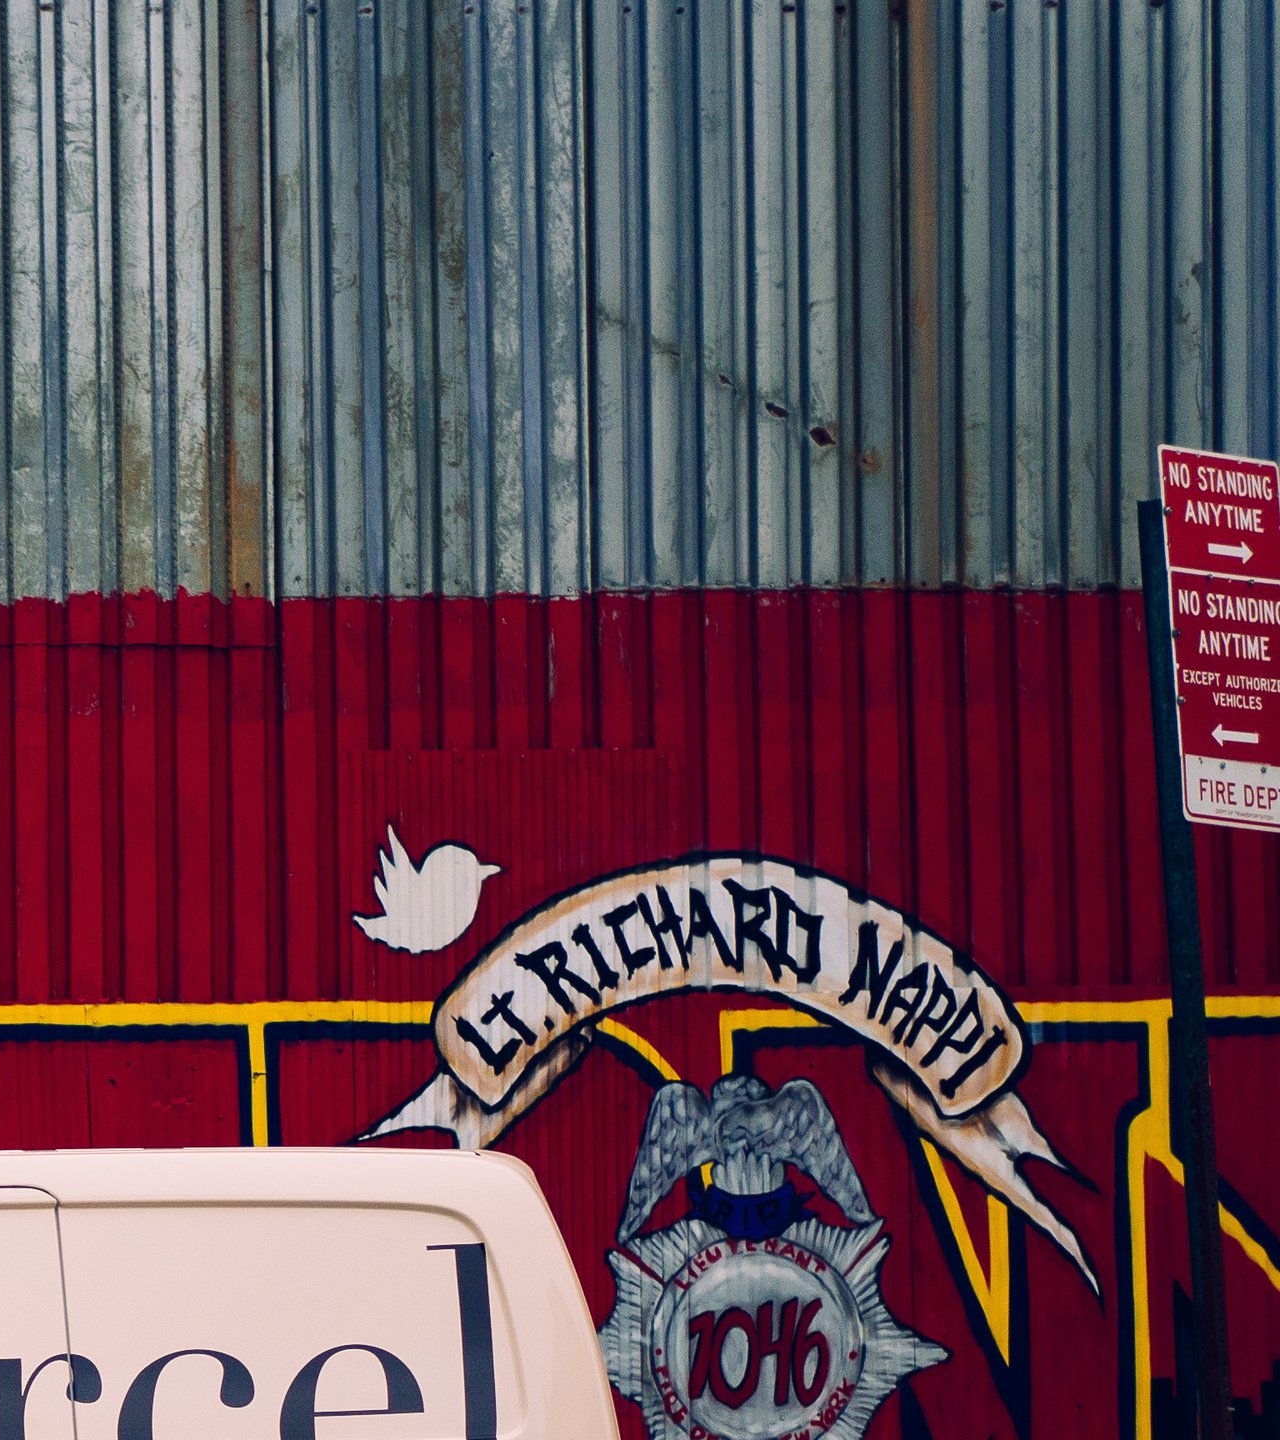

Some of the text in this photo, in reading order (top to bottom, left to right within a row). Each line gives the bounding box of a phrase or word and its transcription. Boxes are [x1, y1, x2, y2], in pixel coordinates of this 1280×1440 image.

[1168, 461, 1273, 501] NO STANDING
[1184, 499, 1265, 534] ANYTIME
[1178, 588, 1201, 617] NO
[1198, 629, 1271, 662] ANYTIME
[1182, 668, 1221, 687] EXCEPT
[1212, 691, 1263, 711] VEHICLES
[1199, 778, 1280, 811] FIRE DEP
[513, 878, 824, 1014] RICHARD
[838, 920, 1008, 1100] NAPPI
[809, 1377, 856, 1432] YORK
